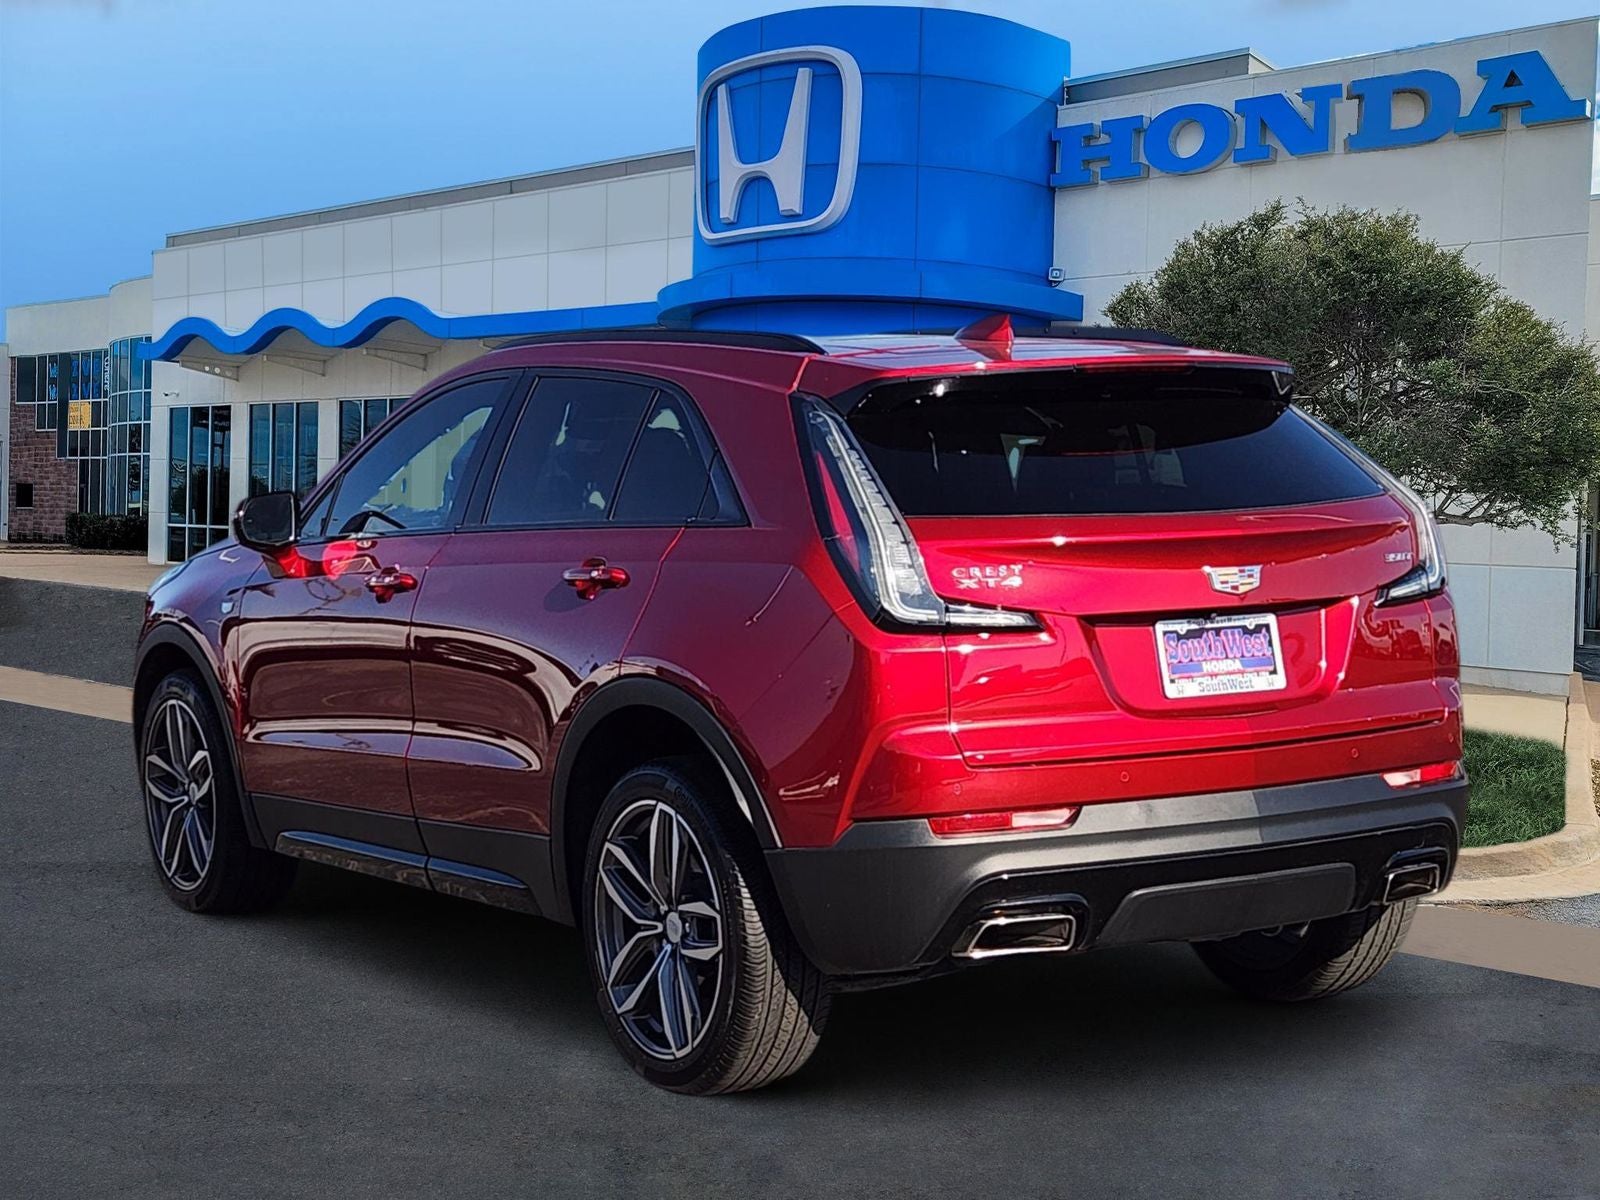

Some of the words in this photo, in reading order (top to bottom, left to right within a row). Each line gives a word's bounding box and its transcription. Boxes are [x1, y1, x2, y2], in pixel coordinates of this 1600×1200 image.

[1050, 50, 1592, 188] HONDA
[951, 564, 1024, 578] CREST
[955, 576, 1024, 589] XT4
[1164, 627, 1273, 663] SouthWest
[1203, 658, 1244, 673] HONDA
[1198, 679, 1255, 693] SouthWest
